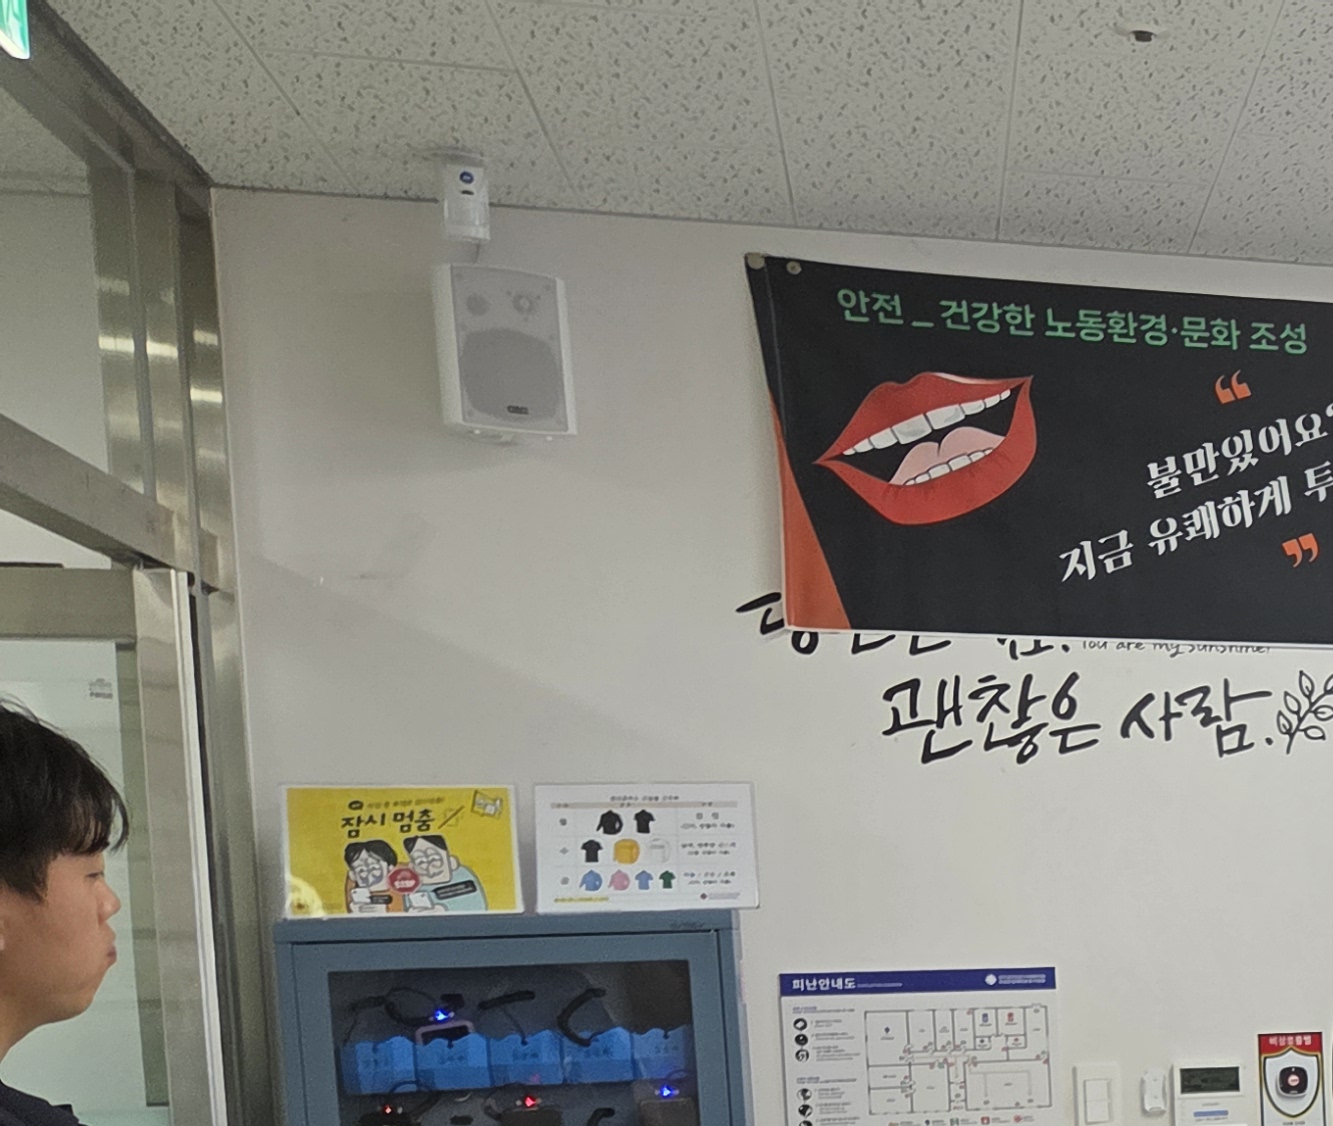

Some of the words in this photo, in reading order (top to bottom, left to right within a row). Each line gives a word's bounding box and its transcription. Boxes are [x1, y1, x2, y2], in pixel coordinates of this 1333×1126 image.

[1045, 307, 1241, 350] 노동환경·문화
[1248, 321, 1309, 355] 조성
[1058, 528, 1135, 583] 지금
[1147, 475, 1292, 556] 유쾌하게
[880, 671, 1102, 764] 괜찮은
[340, 812, 386, 839] 잠시
[391, 808, 436, 834] 멈춤
[791, 977, 857, 992] 피난안내도
